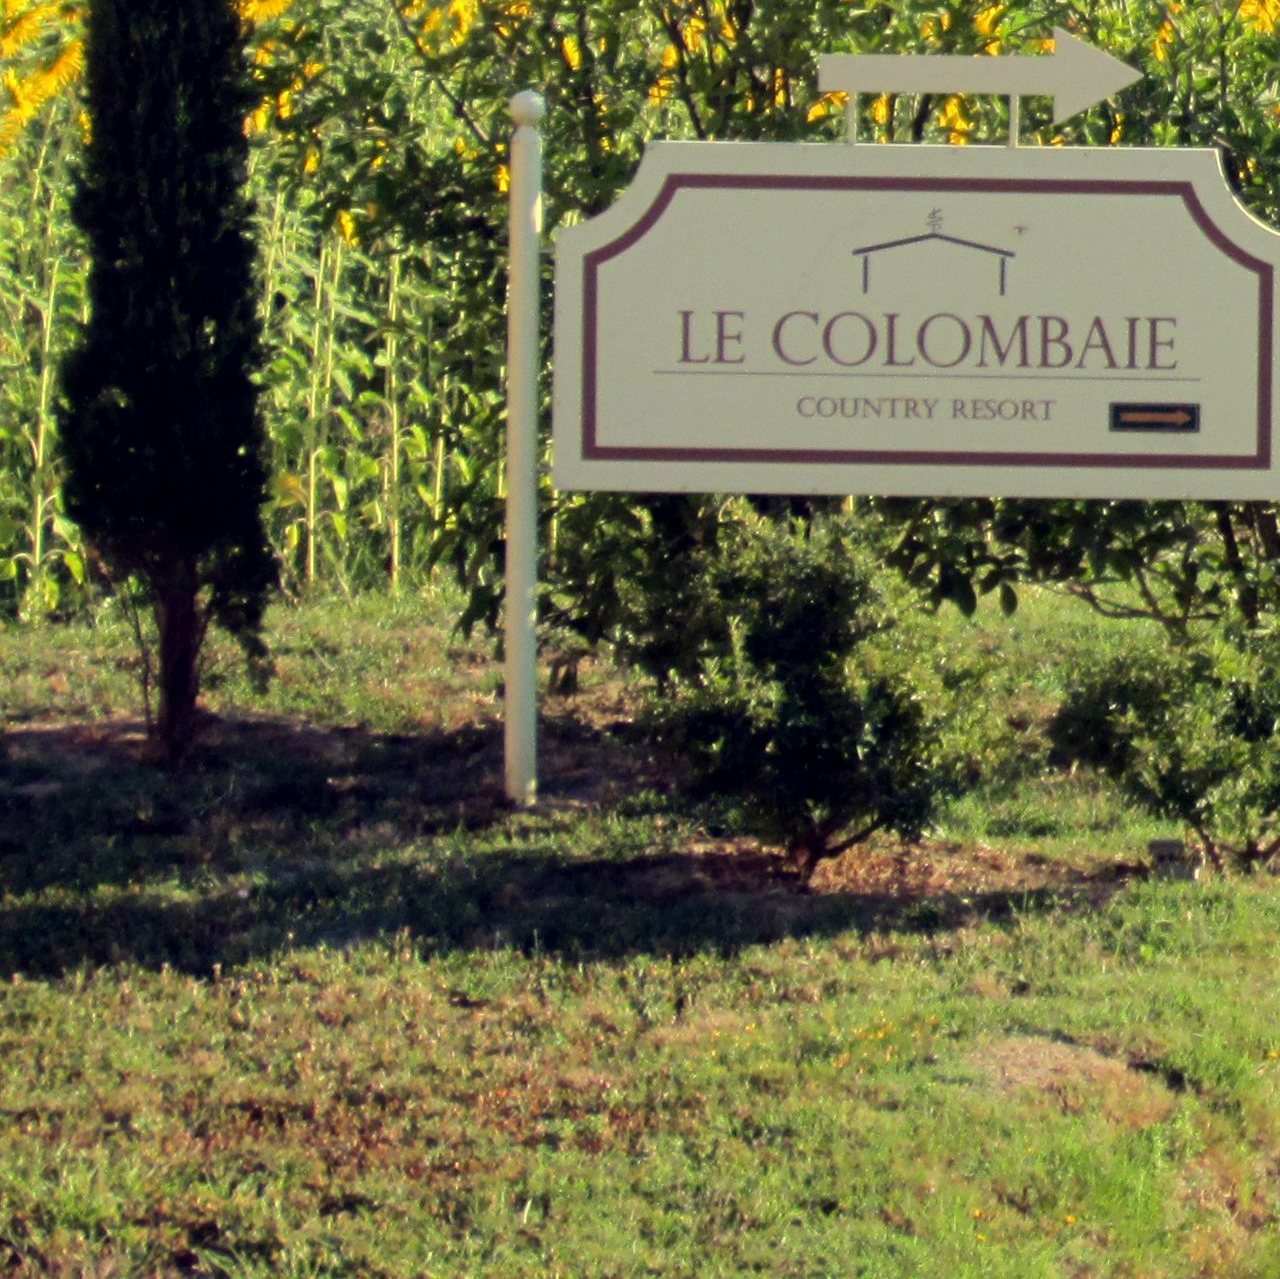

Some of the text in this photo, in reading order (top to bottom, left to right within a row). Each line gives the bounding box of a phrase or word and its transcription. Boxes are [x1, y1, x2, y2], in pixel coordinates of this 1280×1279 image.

[677, 310, 1178, 370] LE COLOMBAIE
[797, 396, 1057, 421] COUNTRY RESORT
